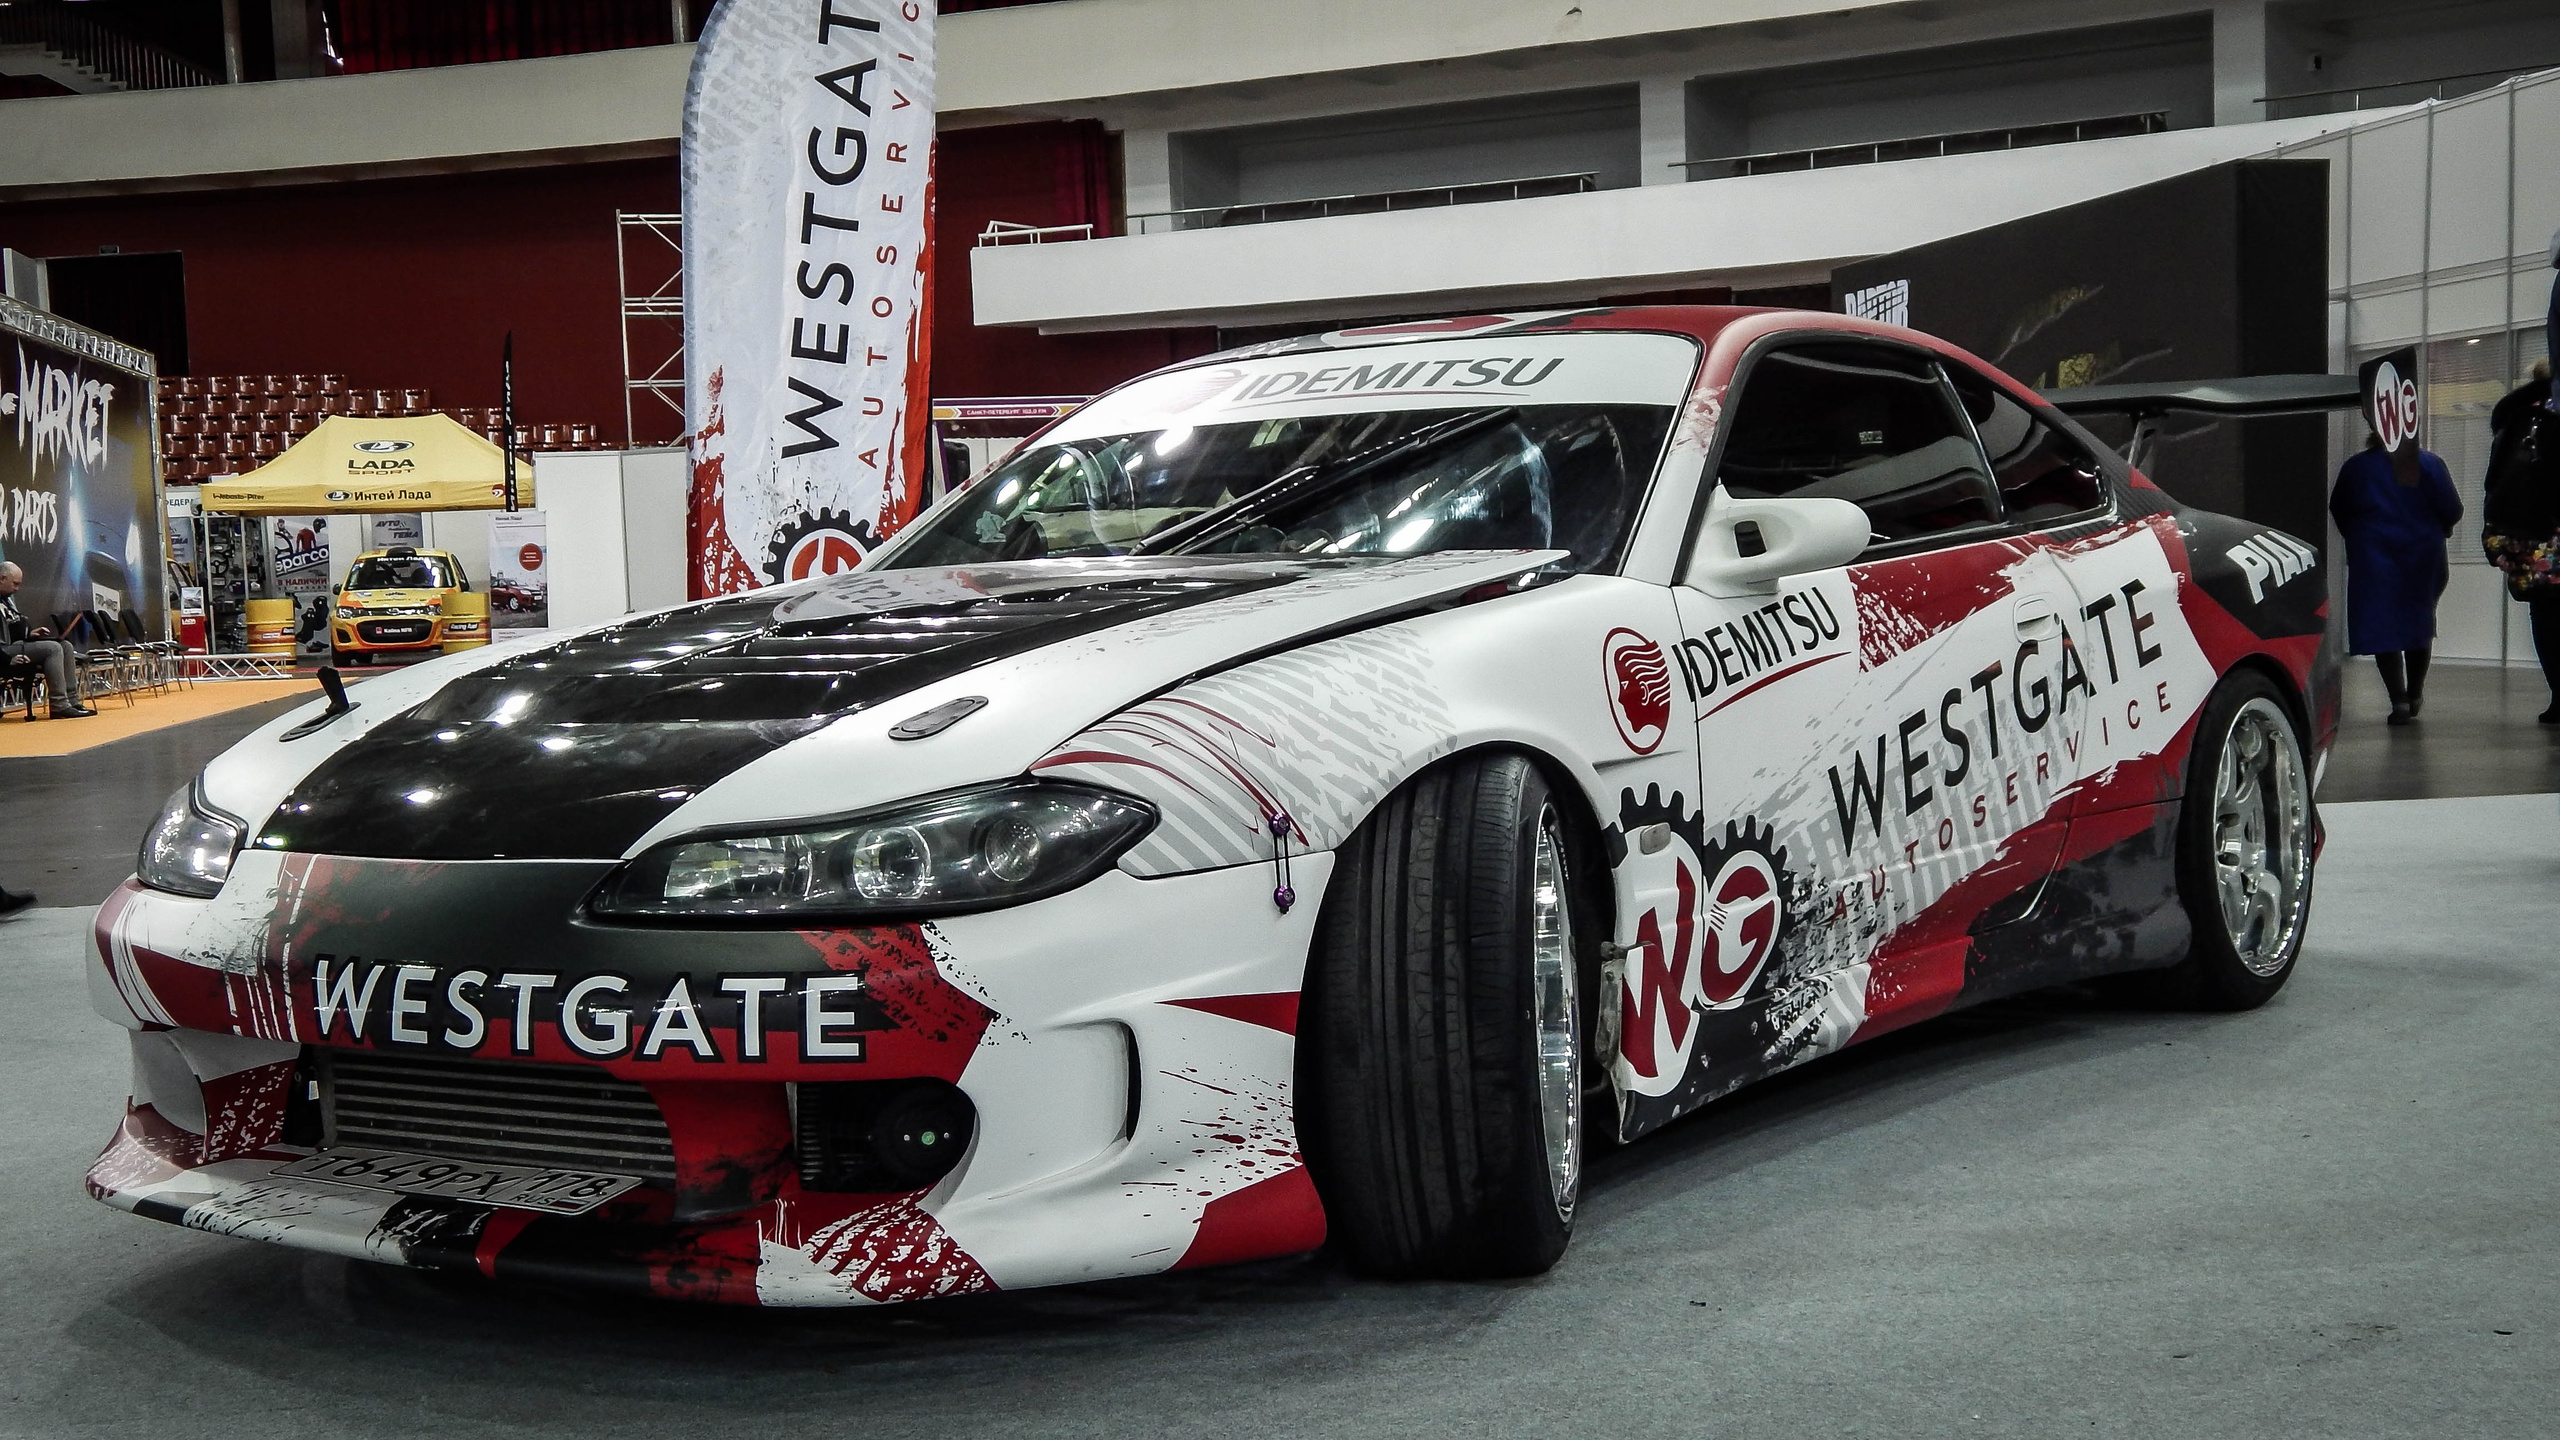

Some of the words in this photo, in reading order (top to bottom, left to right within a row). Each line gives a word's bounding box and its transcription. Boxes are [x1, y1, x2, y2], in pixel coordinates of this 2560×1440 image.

[1232, 357, 1565, 401] IDEMITSU
[2376, 375, 2418, 445] WG
[348, 459, 415, 470] LADA
[354, 490, 395, 501] Интей
[398, 489, 431, 501] Лада
[11, 486, 57, 547] PARTS
[275, 549, 329, 573] sparco
[2226, 530, 2316, 605] PIAA
[1671, 586, 1841, 703] IDEMITSU
[1827, 578, 2163, 858] WESTGATE
[1830, 681, 2172, 928] AUTOSERVICE
[316, 958, 861, 1058] WESTGATE
[511, 1194, 556, 1207] RUS
[524, 1170, 617, 1199] 178
